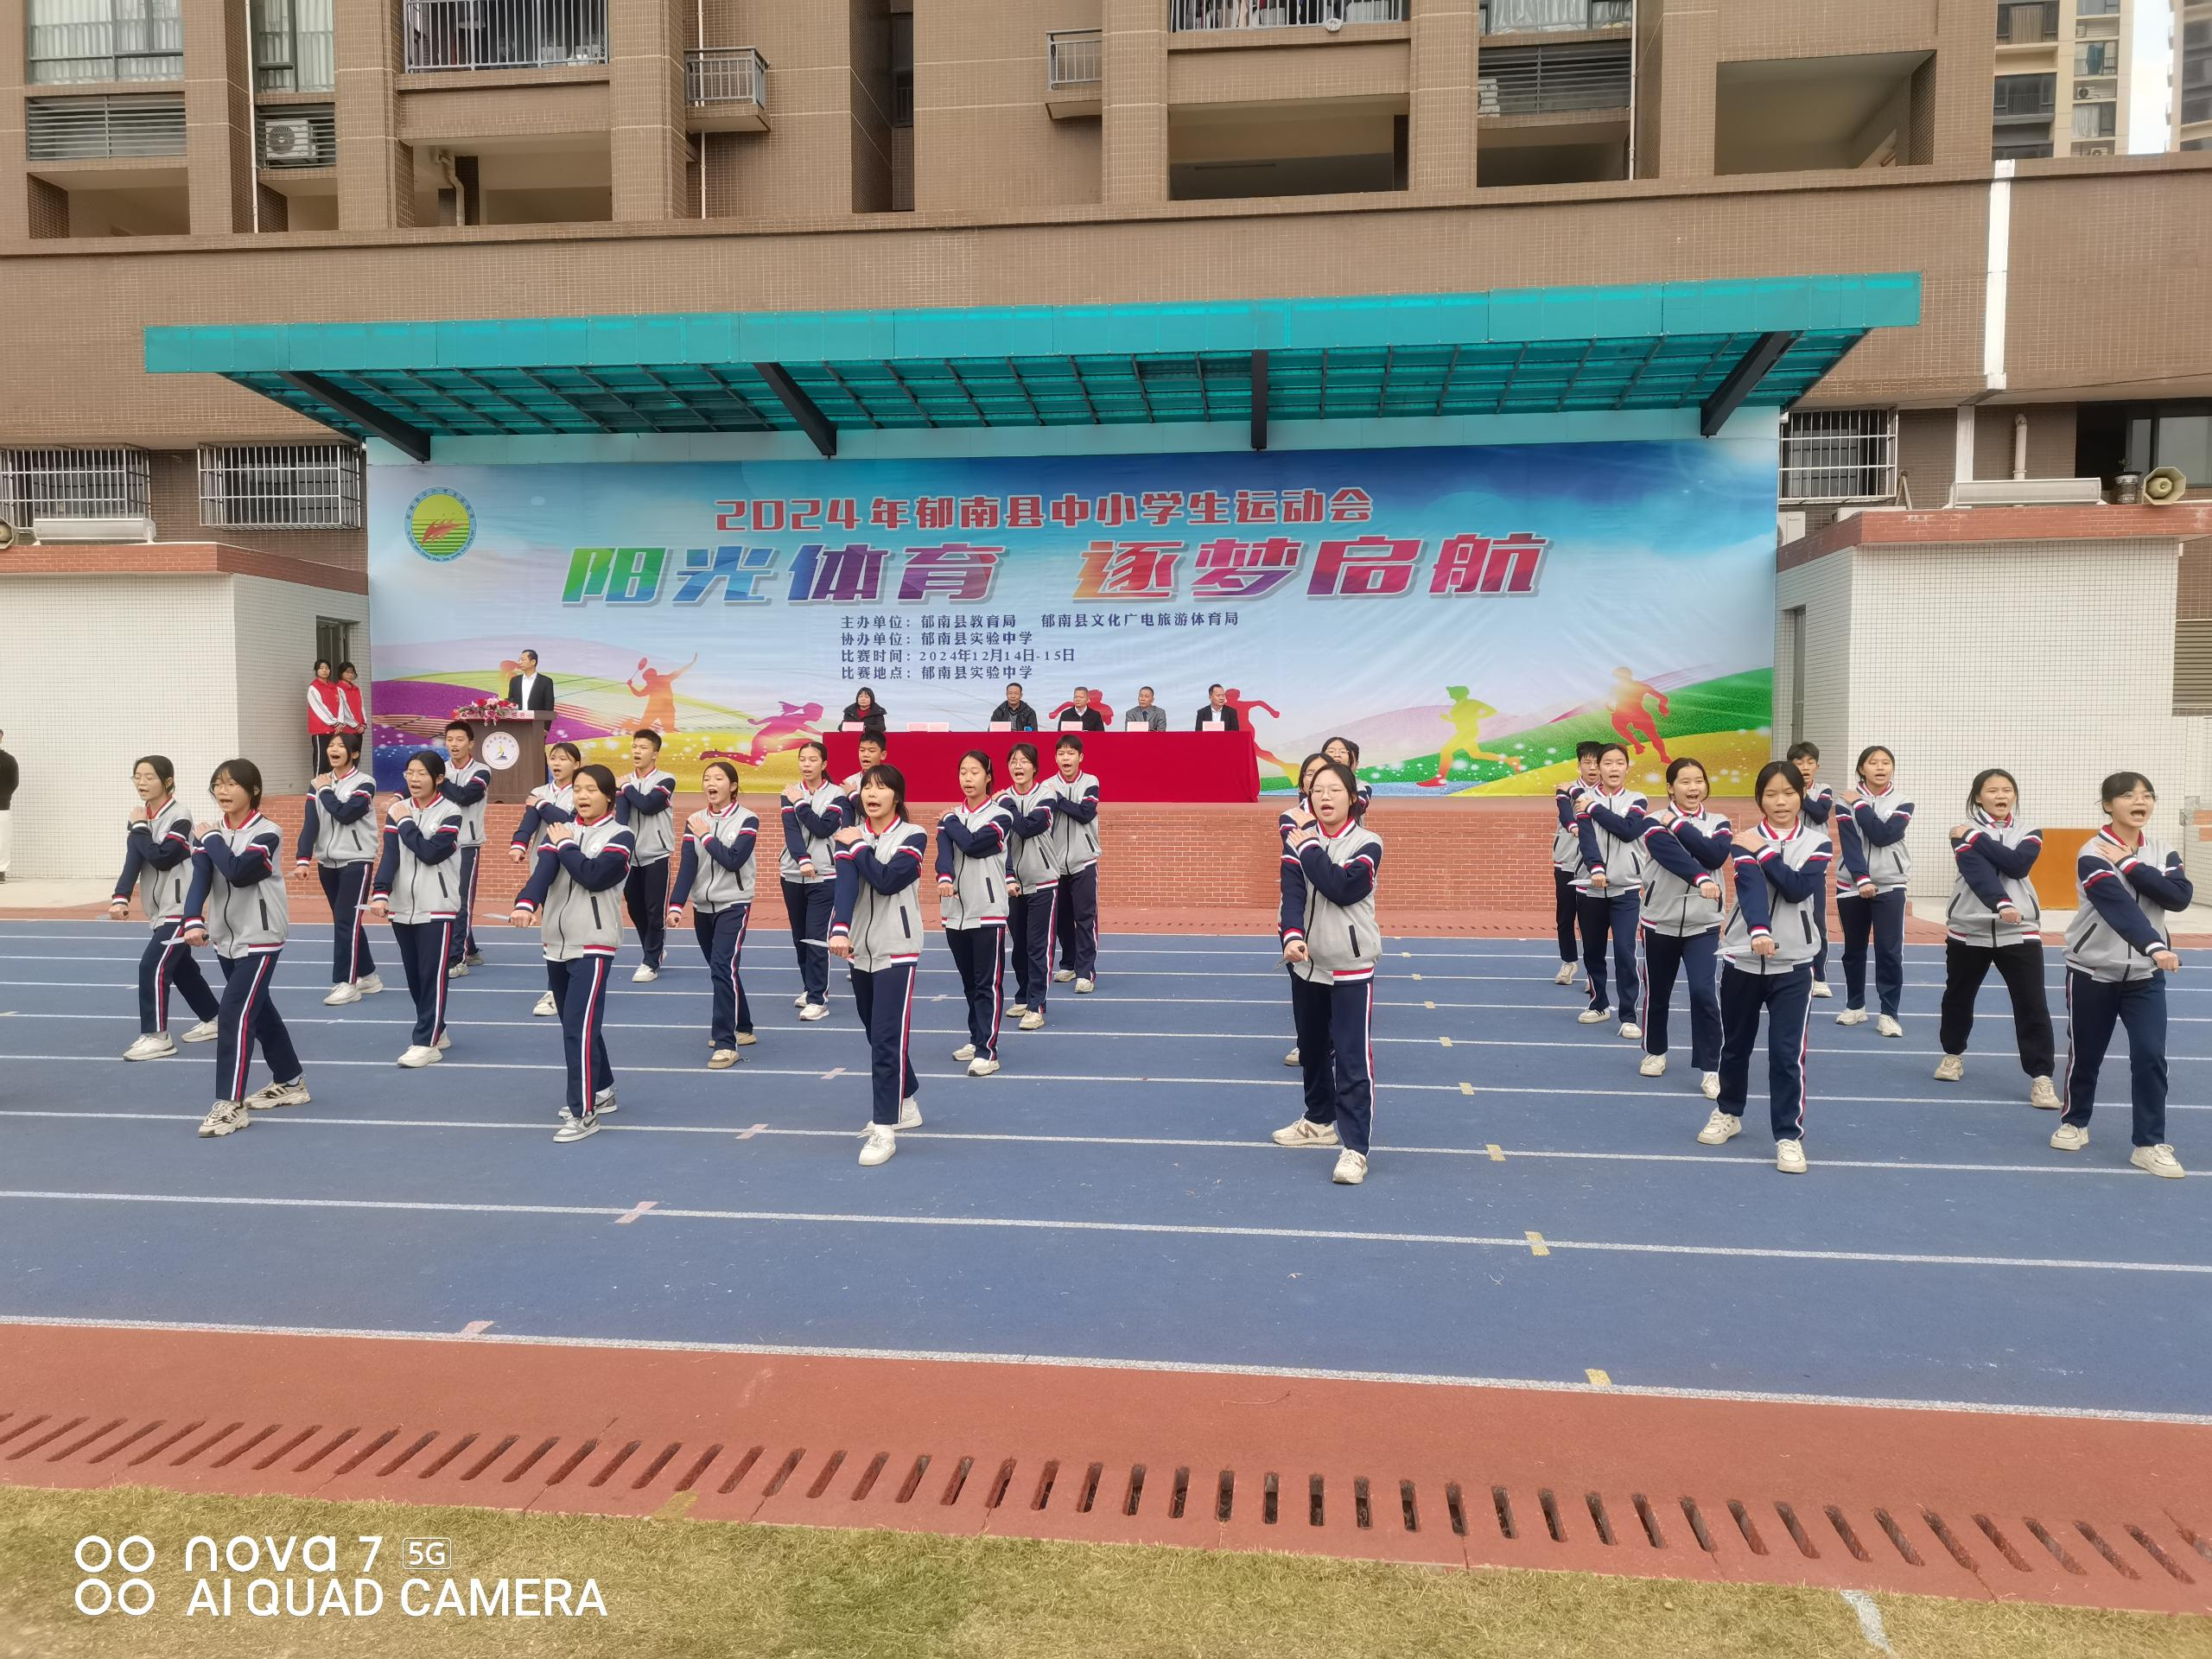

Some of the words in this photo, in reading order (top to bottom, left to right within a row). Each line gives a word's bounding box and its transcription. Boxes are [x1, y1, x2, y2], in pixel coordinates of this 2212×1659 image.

[561, 542, 1005, 603] 阳光体育
[1071, 532, 1548, 600] 逐梦启航
[1040, 612, 1239, 628] 郁南县文化广电旅游体育局
